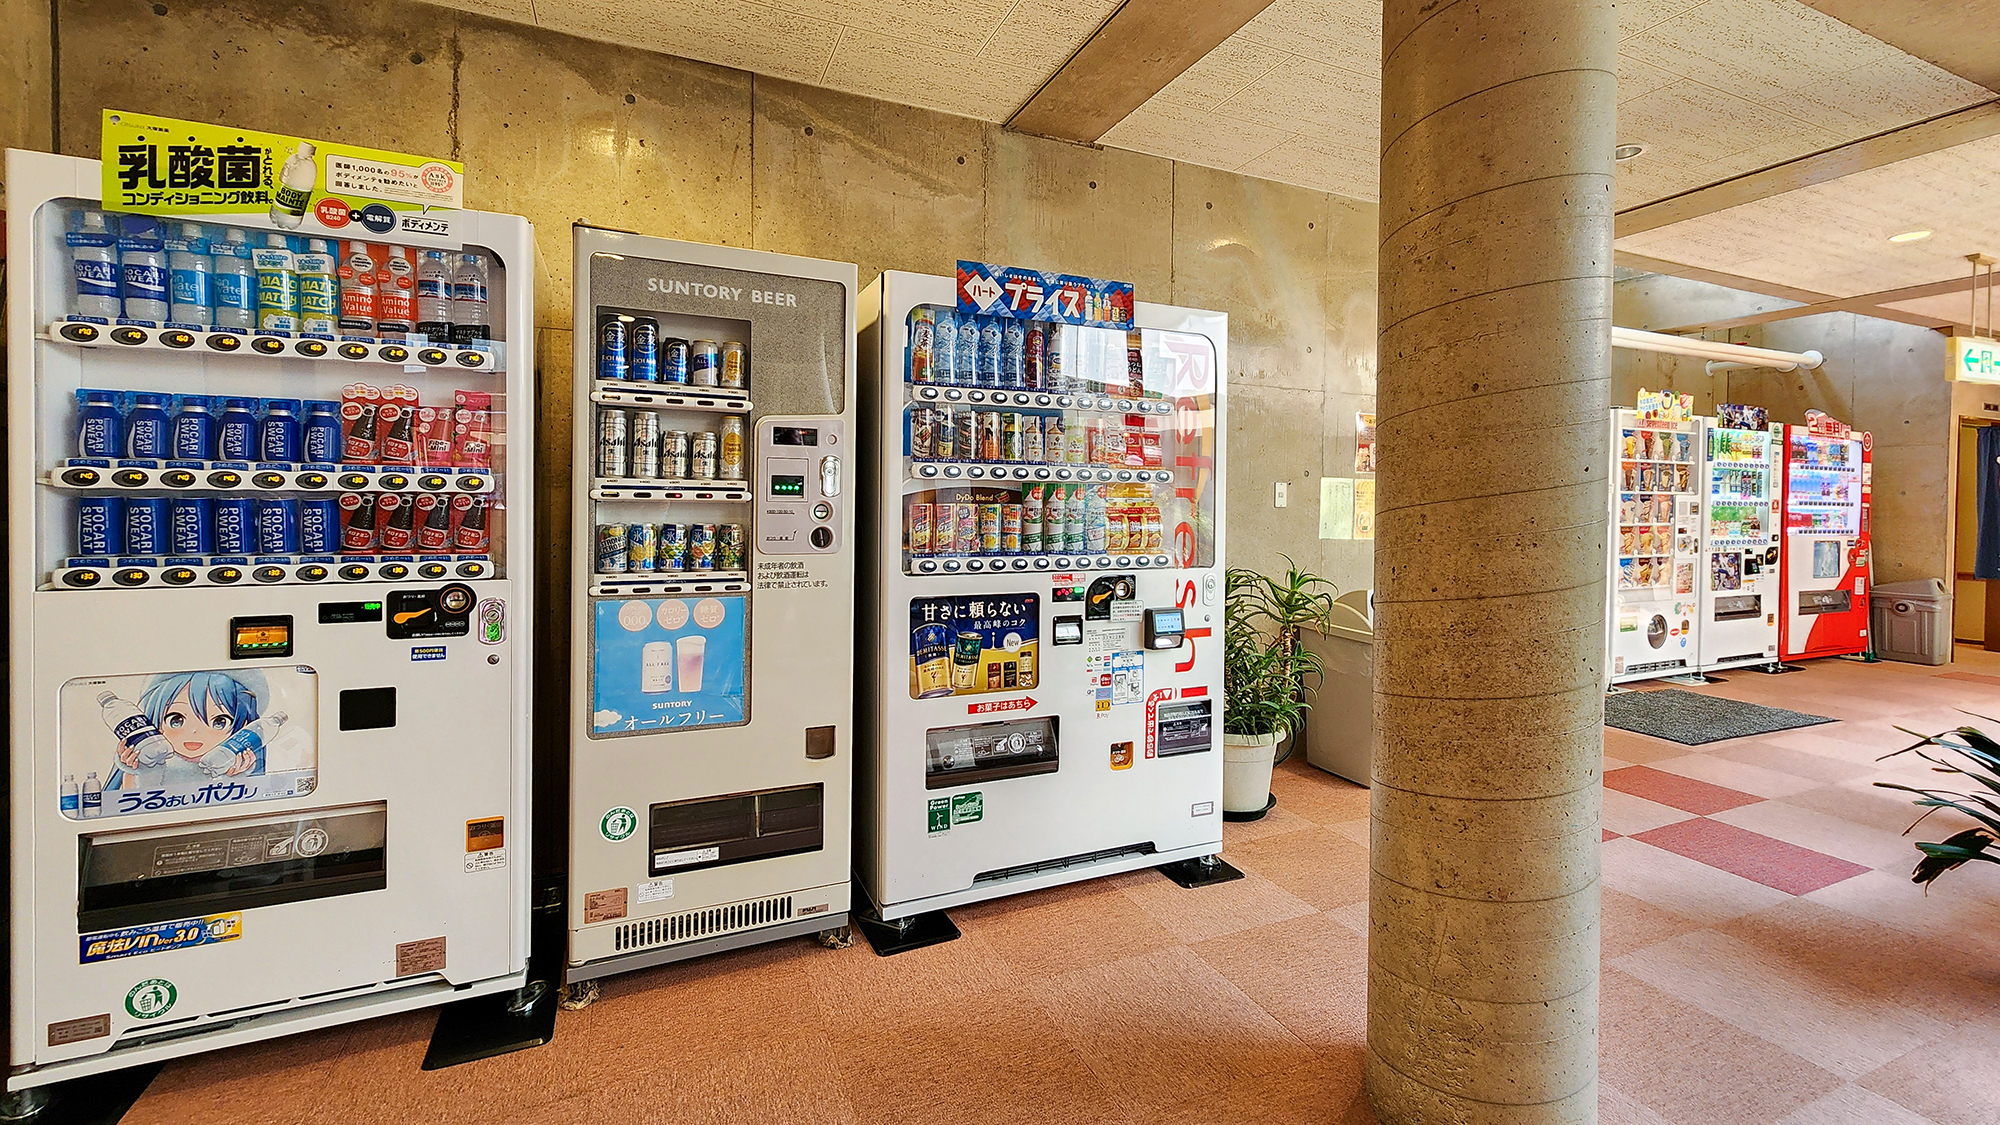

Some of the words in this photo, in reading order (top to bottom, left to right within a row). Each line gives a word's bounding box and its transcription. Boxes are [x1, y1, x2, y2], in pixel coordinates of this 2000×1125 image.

[118, 144, 262, 189] 乳酸菌
[262, 147, 274, 189] がとれる、
[335, 162, 419, 180] 医師1,000名の95%が
[122, 190, 274, 206] コンディショニング飲料。
[335, 180, 383, 193] 回答しました。
[320, 206, 347, 216] 乳酸菌
[365, 213, 392, 224] 電解質
[401, 218, 449, 232] ボディメンテ
[342, 293, 373, 304] Amino
[381, 297, 410, 308] Amino
[648, 277, 743, 301] SUNTORY
[751, 289, 798, 308] BEER
[973, 285, 996, 298] ハート
[1004, 282, 1081, 319] プライス
[87, 419, 95, 449] SWEAT
[95, 419, 104, 453] POCARI
[136, 420, 144, 451] SWEAT
[143, 420, 153, 454] POCARI
[181, 417, 189, 451] SWEAT
[189, 418, 199, 455] POCARI
[226, 423, 234, 453] SWEAT
[234, 423, 242, 456] POCARI
[267, 422, 275, 454] SWEAT
[275, 422, 284, 457] POCARI
[316, 426, 324, 458] POCARI
[956, 493, 973, 501] DyDo
[82, 506, 92, 550] SWEAT
[92, 506, 105, 554] POCARI
[129, 506, 139, 549] SWEAT
[139, 506, 153, 554] POCARI
[175, 506, 185, 548] SWEAT
[185, 506, 198, 552] POCARI
[219, 507, 228, 548] SWEAT
[228, 507, 240, 552] POCARI
[262, 507, 272, 548] SWEAT
[272, 507, 283, 552] POCARI
[303, 508, 312, 548] SWEAT
[312, 508, 322, 552] POCARI
[757, 562, 804, 570] 未成年者の飲酒
[757, 571, 809, 579] および飲酒運転は
[756, 581, 829, 589] 法律で禁止されています。
[922, 601, 1026, 621] 甘さに頼らない
[973, 618, 1026, 630] 最高峰のコク
[1006, 638, 1020, 647] New
[624, 710, 725, 731] オールフリー
[652, 700, 693, 710] SUNTORY
[976, 700, 1031, 713] お菓子はあちら
[117, 781, 257, 813] うるおいポカリ
[173, 928, 199, 941] 3.0
[134, 1003, 173, 1019] リサイクル
